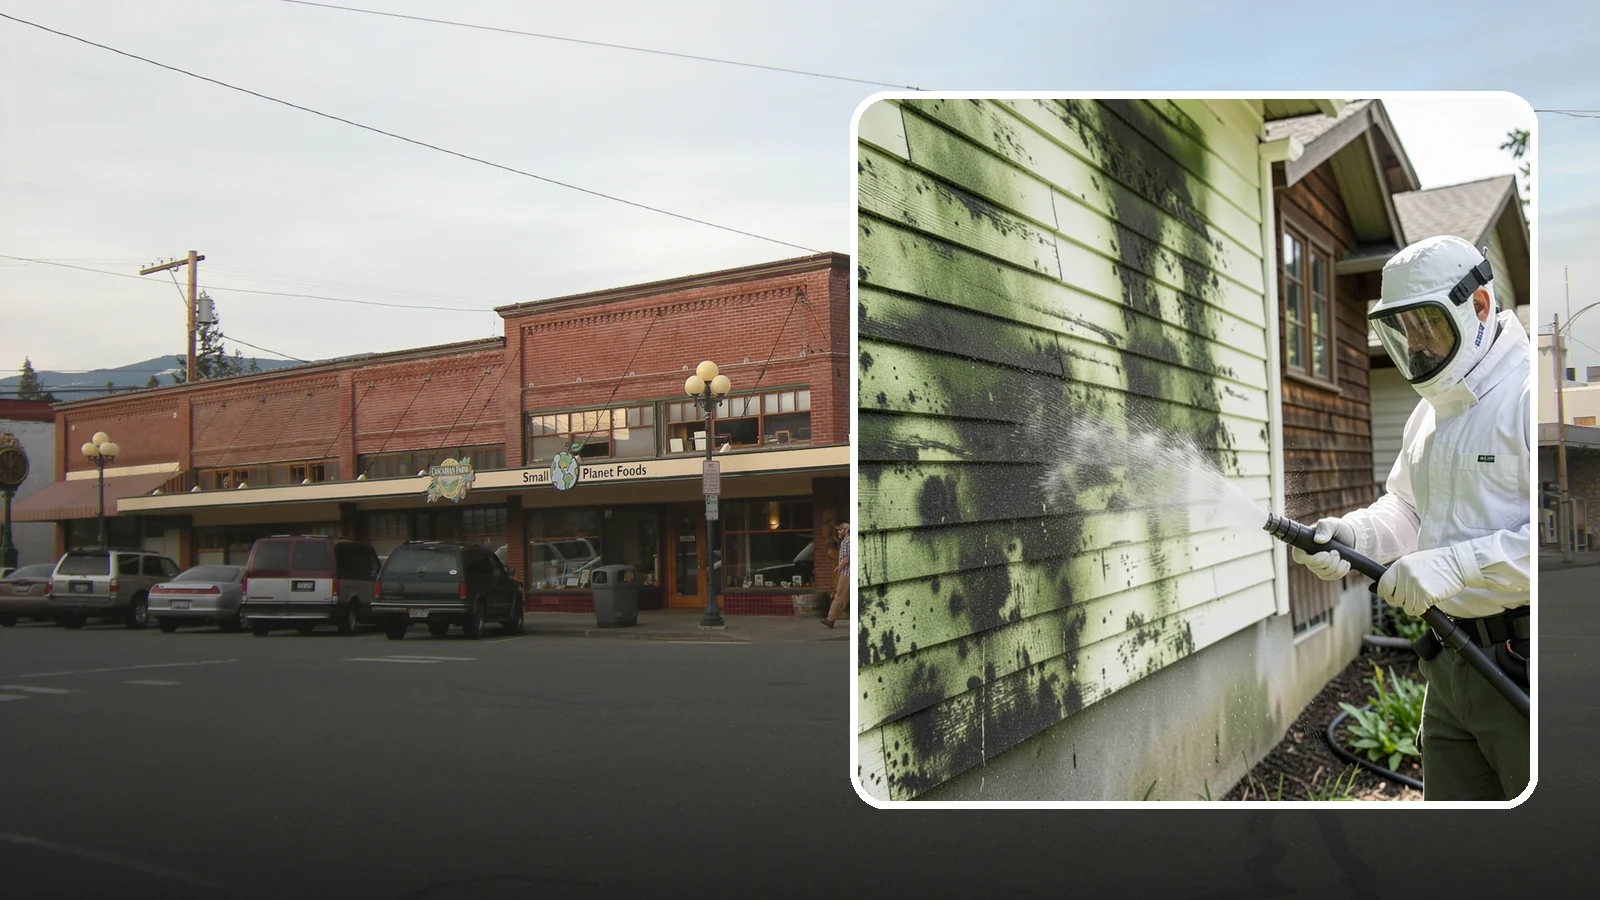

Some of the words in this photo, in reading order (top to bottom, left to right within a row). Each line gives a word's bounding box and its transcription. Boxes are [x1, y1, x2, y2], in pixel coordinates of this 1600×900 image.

[431, 466, 456, 476] CASCADIAN
[523, 471, 549, 483] Small
[583, 467, 614, 479] Planet
[617, 464, 647, 477] Foods
